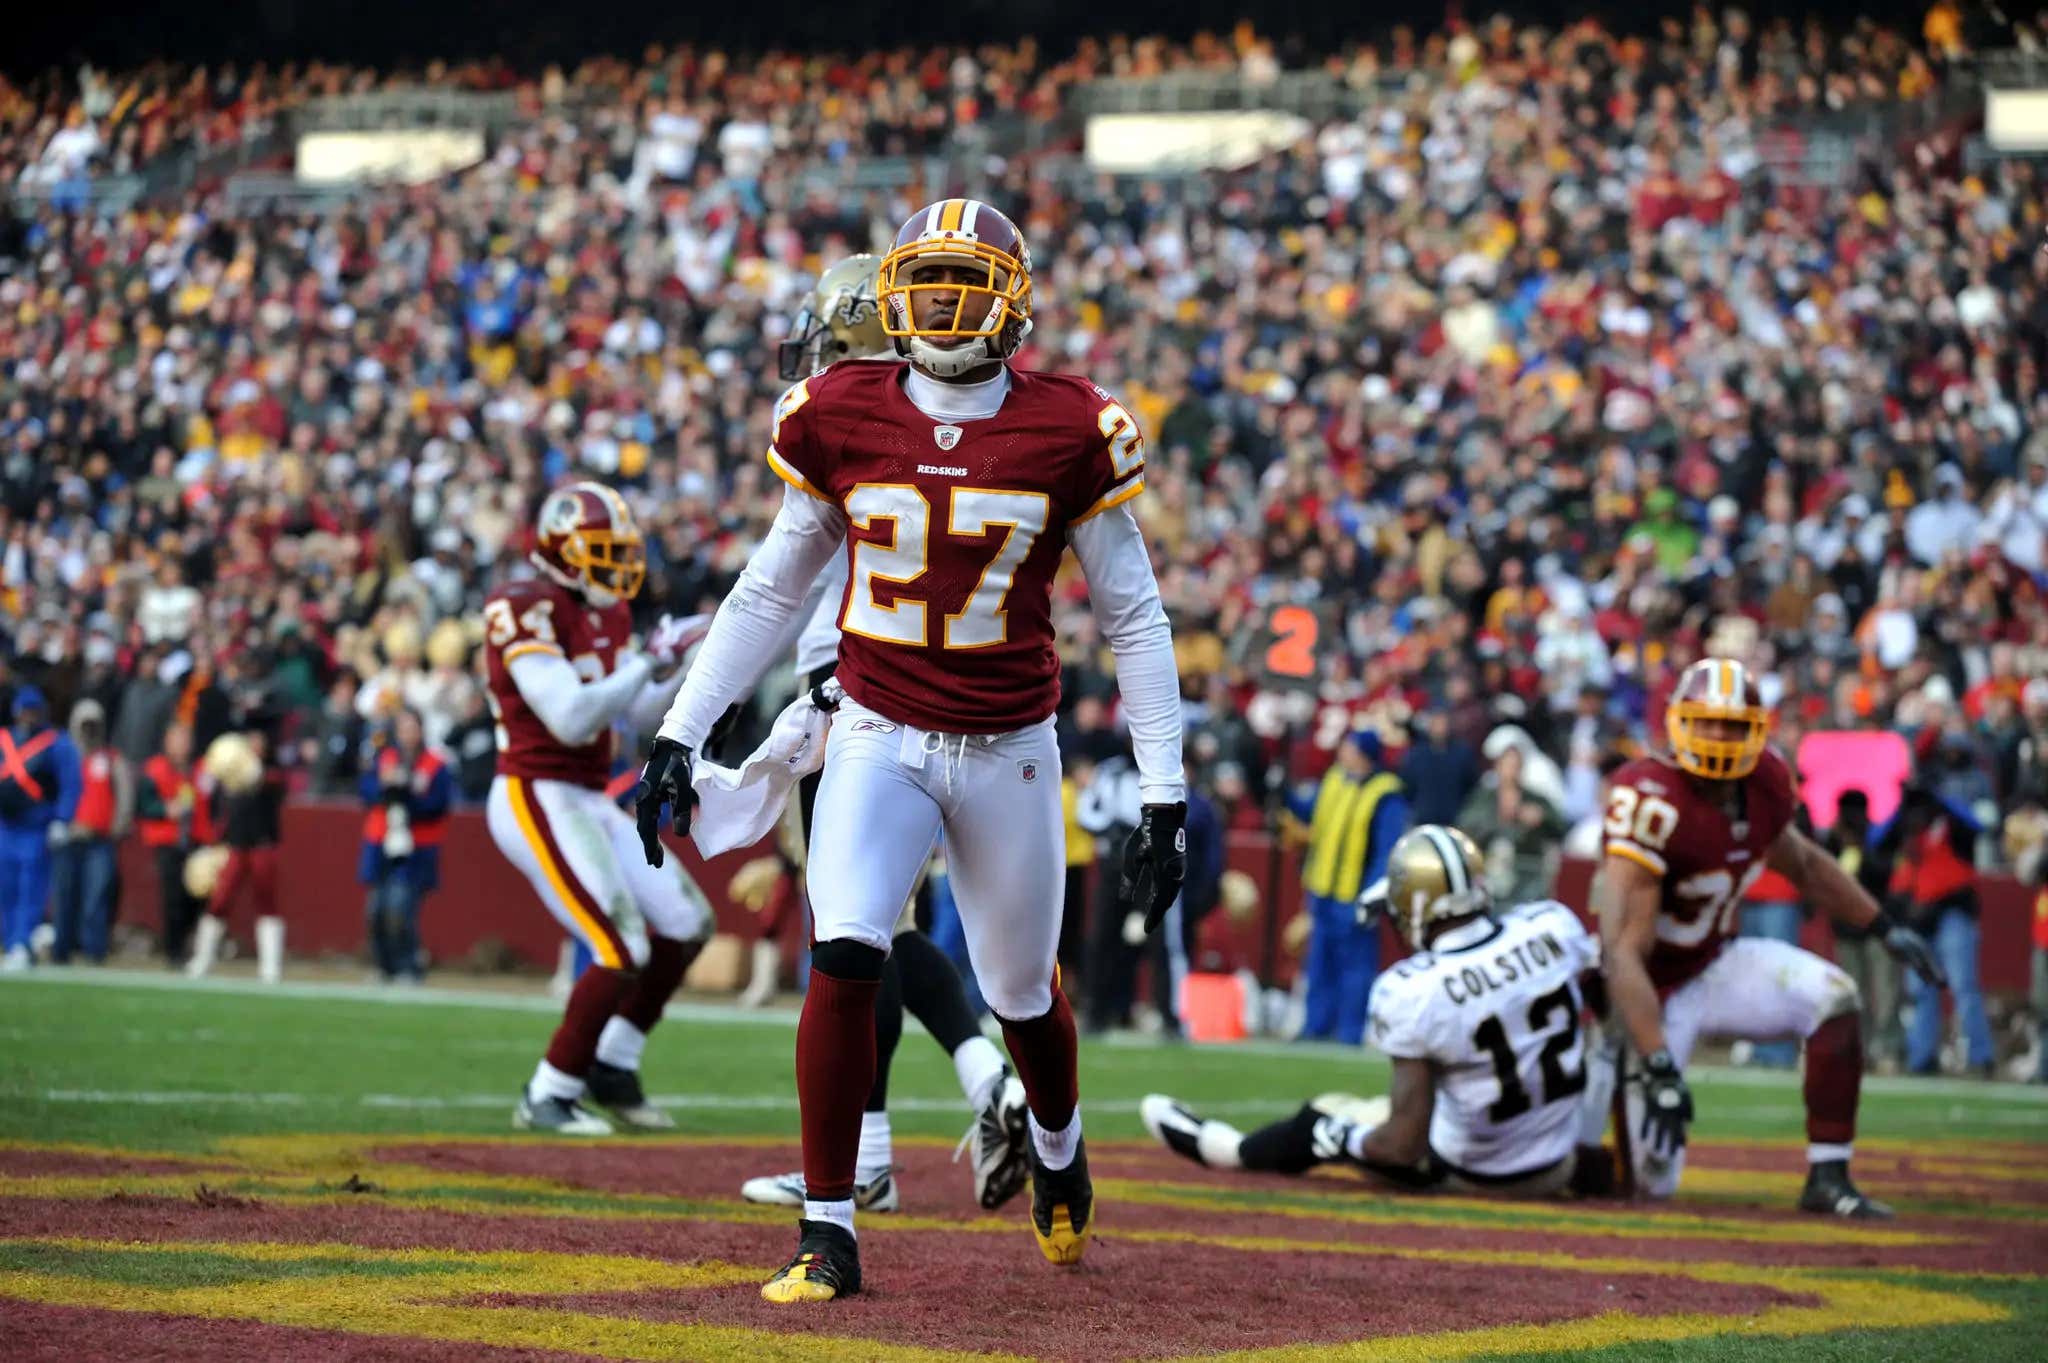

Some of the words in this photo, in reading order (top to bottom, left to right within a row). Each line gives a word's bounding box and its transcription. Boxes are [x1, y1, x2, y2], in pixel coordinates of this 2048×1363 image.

[916, 464, 968, 477] REDSKINS
[842, 483, 1050, 649] 27
[484, 598, 556, 646] 34
[1266, 605, 1318, 676] 2
[1605, 785, 1680, 850] 30
[1443, 931, 1566, 1005] COLSTON
[1472, 980, 1588, 1124] 12
